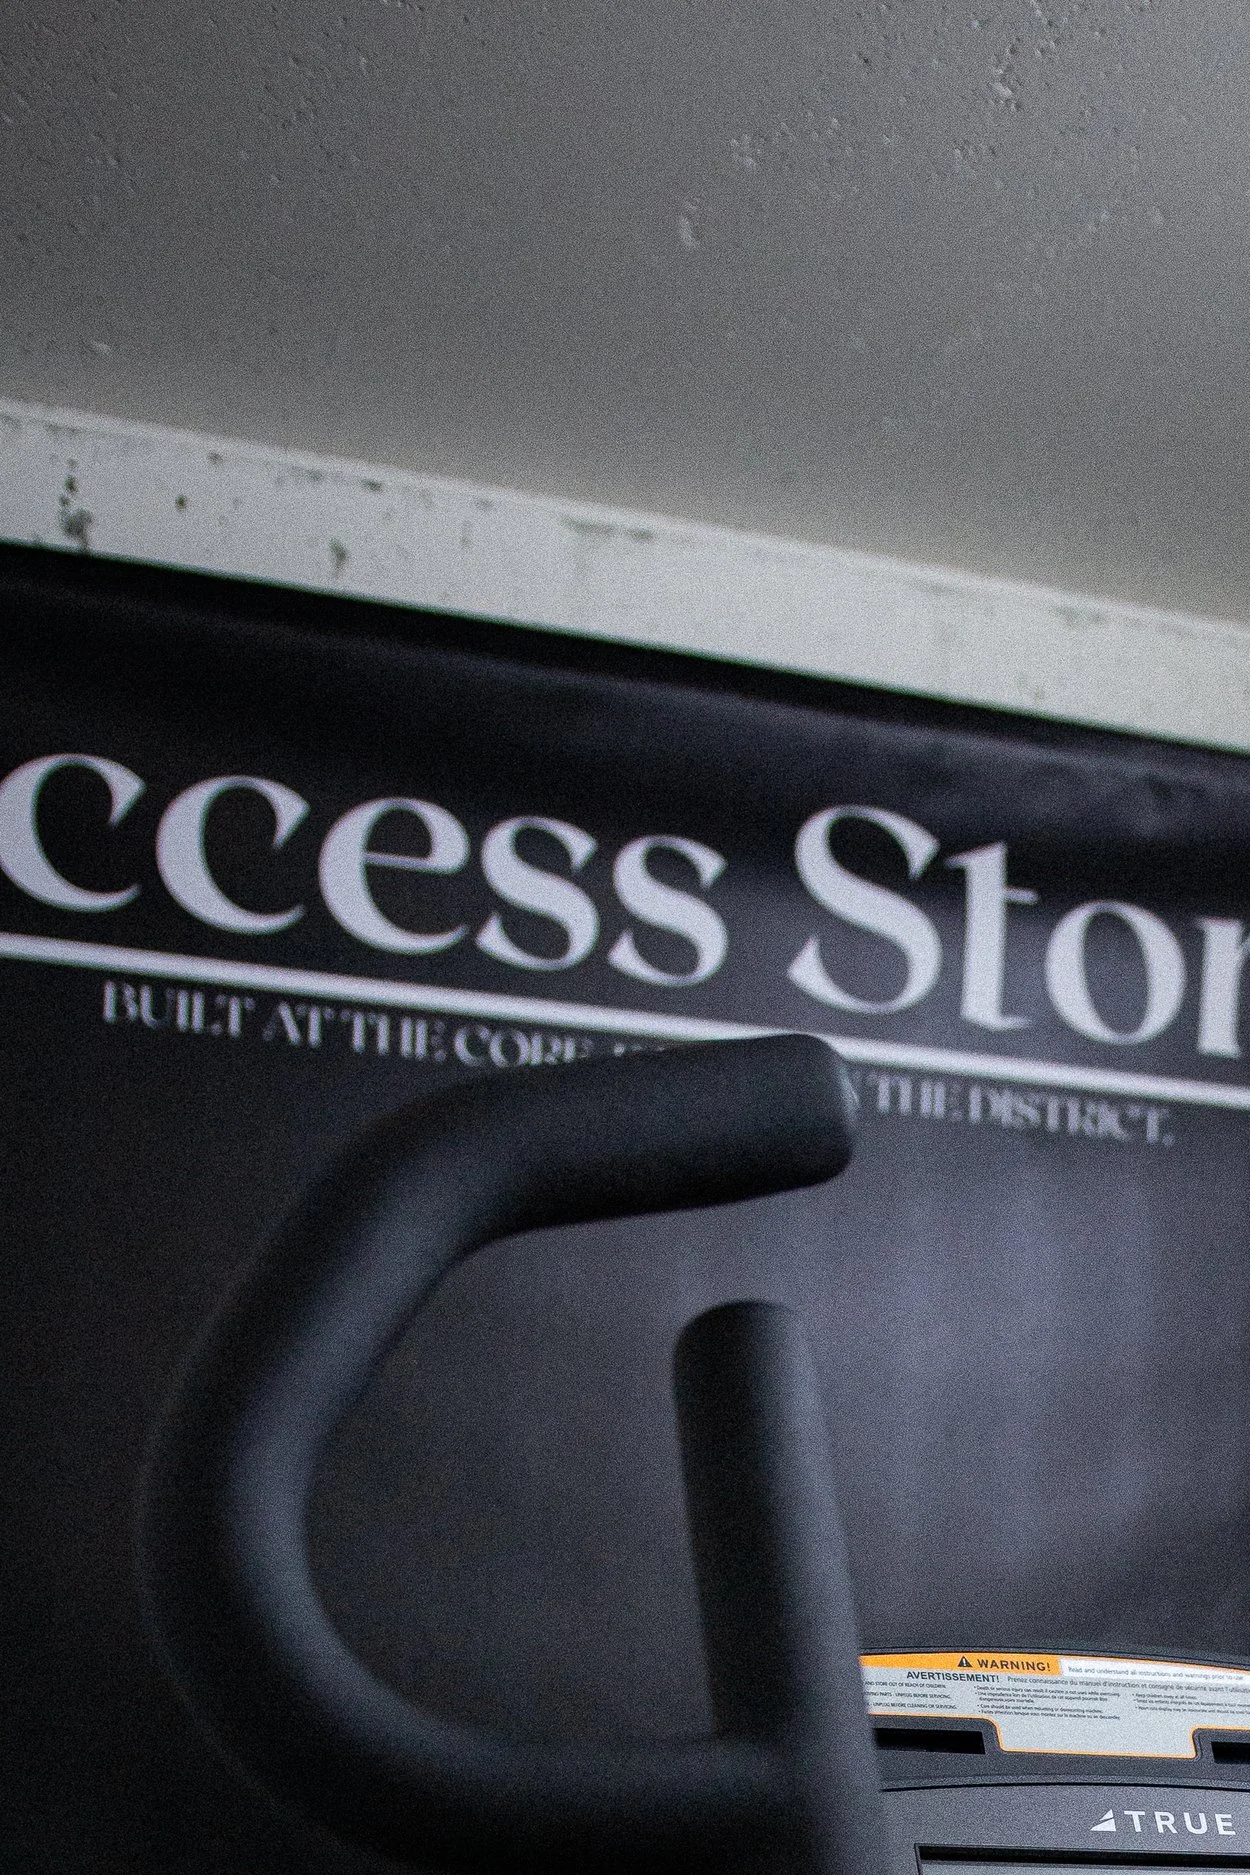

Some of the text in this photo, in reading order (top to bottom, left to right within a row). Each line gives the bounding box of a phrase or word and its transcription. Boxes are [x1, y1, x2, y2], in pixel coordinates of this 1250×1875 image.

[0, 752, 730, 987] ccess
[102, 979, 256, 1039] BUILT
[260, 1000, 337, 1049] AT
[338, 1007, 447, 1063] THE
[867, 1072, 964, 1122] THE
[967, 1083, 1176, 1148] DISTRICT.
[906, 1672, 1000, 1682] AVERTISSEMENT!
[977, 1658, 1051, 1672] WARNING!
[1007, 1675, 1027, 1683] Prenez
[1029, 1678, 1068, 1686] connaissance
[1123, 1810, 1237, 1836] TRUE
